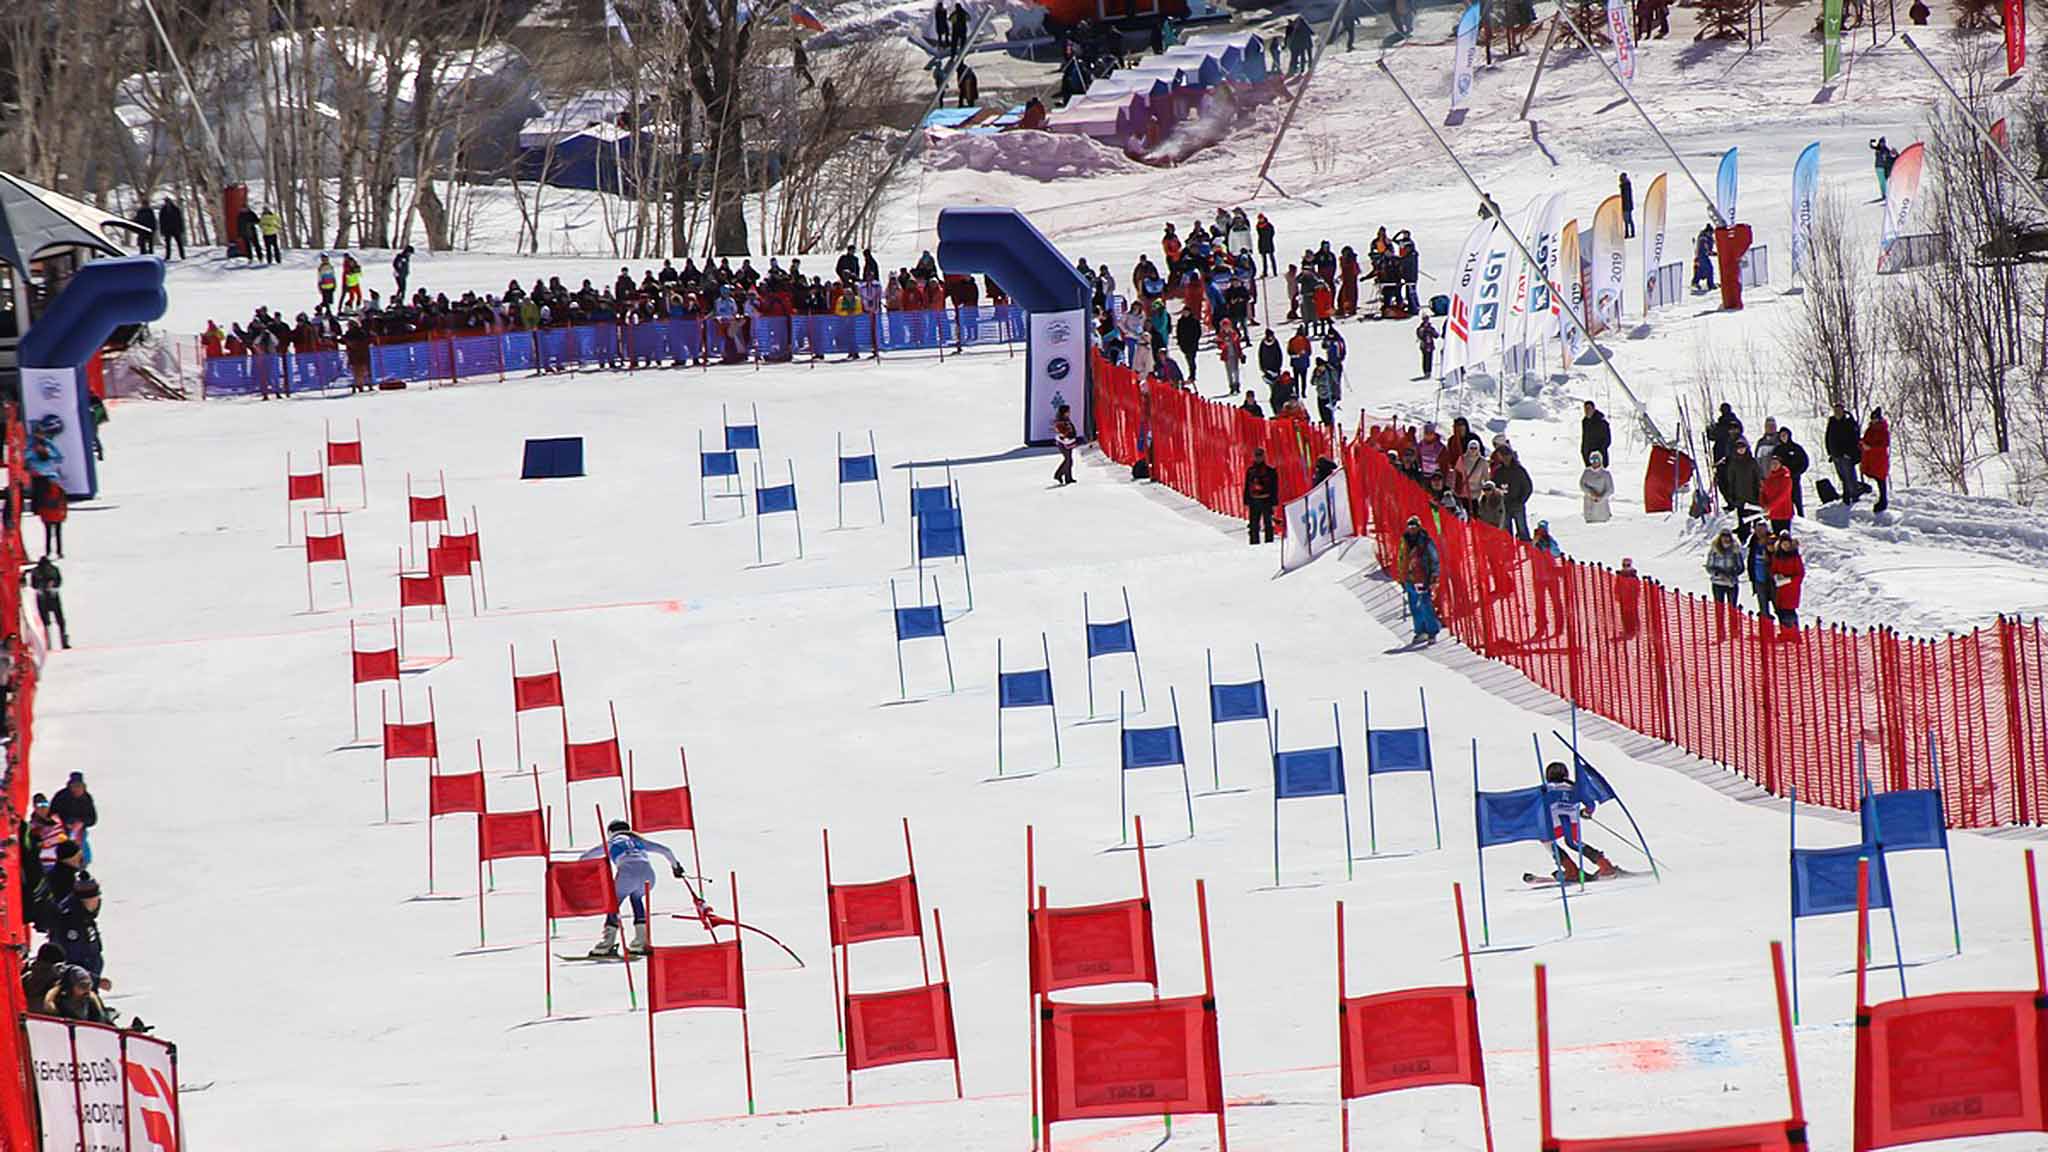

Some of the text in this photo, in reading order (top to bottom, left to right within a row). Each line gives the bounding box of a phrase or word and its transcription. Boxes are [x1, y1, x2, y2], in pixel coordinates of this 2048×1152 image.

[1535, 231, 1549, 282] SGT
[1653, 232, 1665, 263] 2019
[1461, 250, 1479, 287] ФГК
[1480, 248, 1506, 298] SGT
[1610, 252, 1623, 284] 2019
